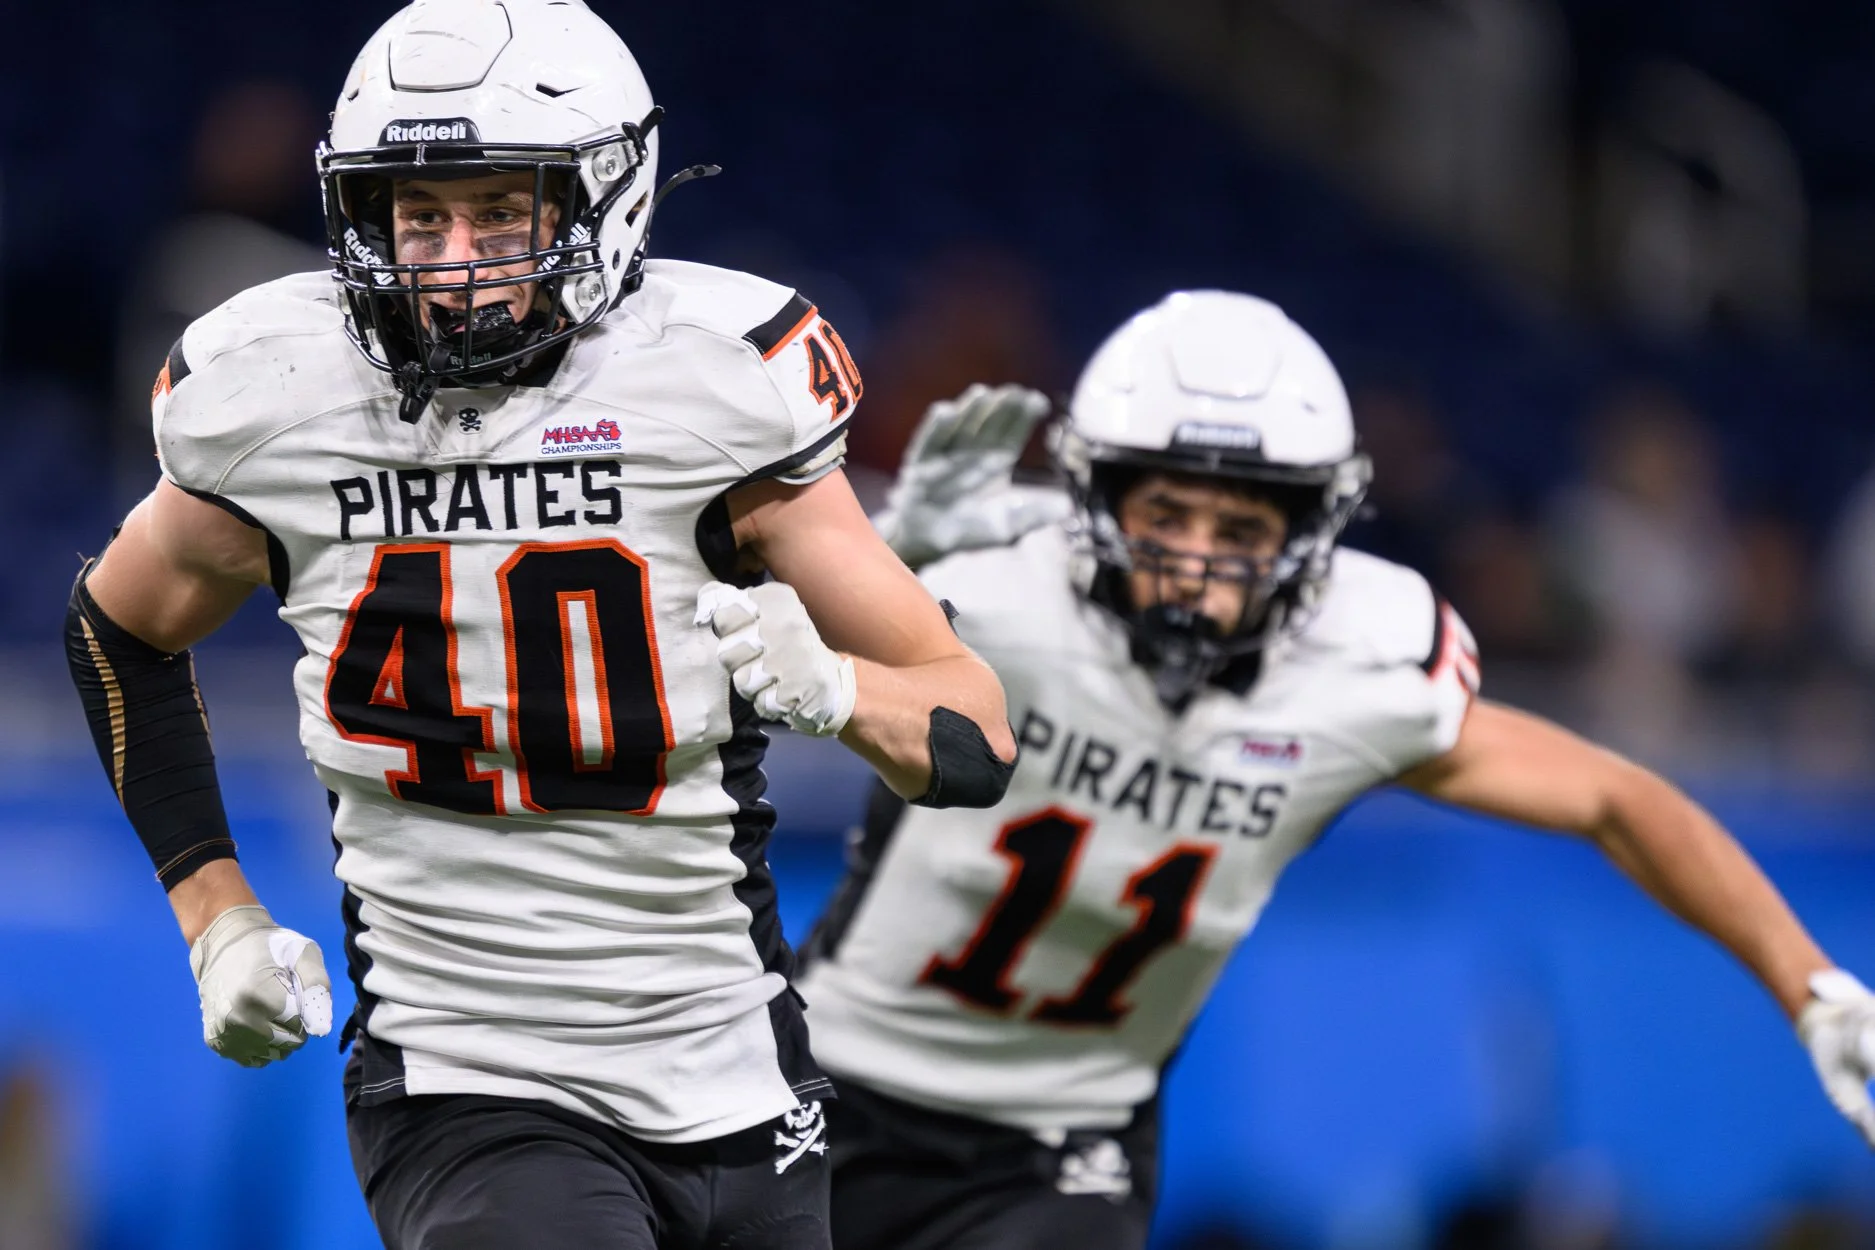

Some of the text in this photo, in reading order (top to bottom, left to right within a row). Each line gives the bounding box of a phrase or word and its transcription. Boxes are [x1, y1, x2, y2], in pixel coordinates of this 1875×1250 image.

[386, 121, 467, 142] Riddell
[803, 320, 863, 423] 40
[541, 420, 615, 445] MHSAA
[541, 442, 622, 454] CHAMPIONSHIPS
[330, 460, 623, 541] PIRATES
[324, 538, 676, 817] 40
[1019, 707, 1287, 838] PIRATES
[916, 804, 1222, 1028] 11
